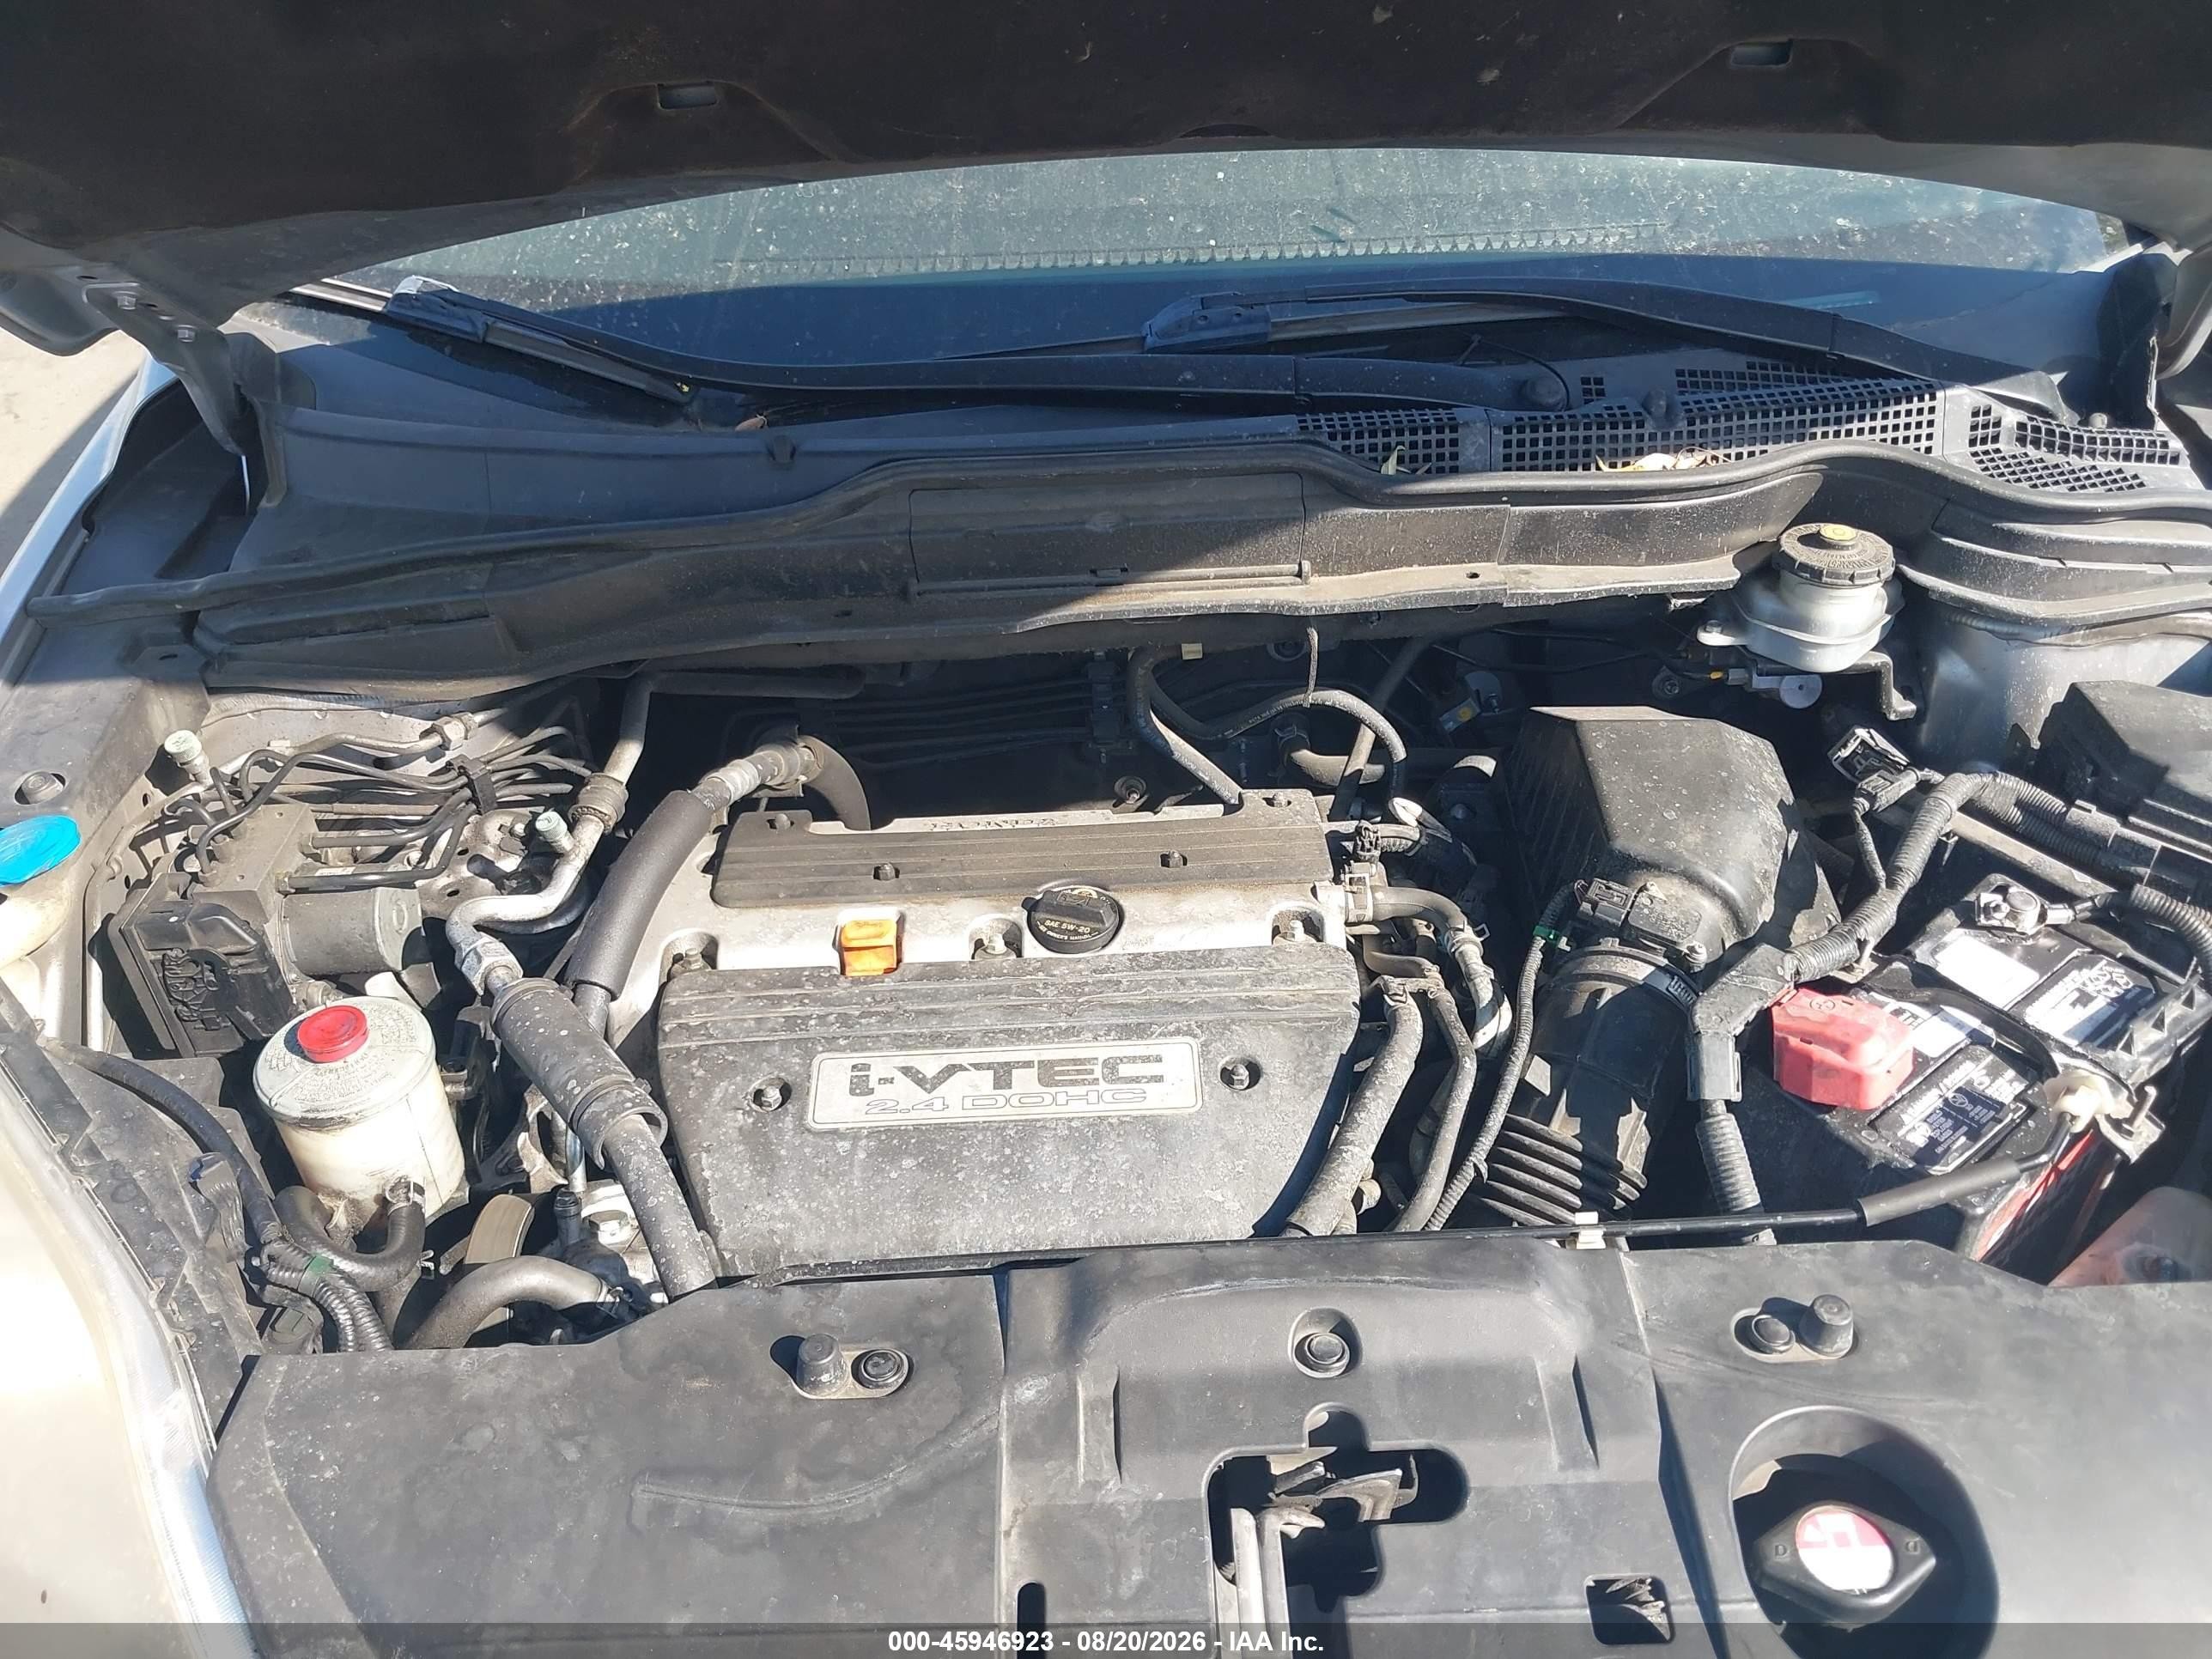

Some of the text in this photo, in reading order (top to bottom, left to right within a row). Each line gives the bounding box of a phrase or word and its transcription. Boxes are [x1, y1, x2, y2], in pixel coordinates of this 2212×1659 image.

[1044, 920, 1091, 933] SAE 5W-20
[849, 1054, 1164, 1097] i-VTEC
[865, 1088, 1147, 1115] 2.4 DOHC
